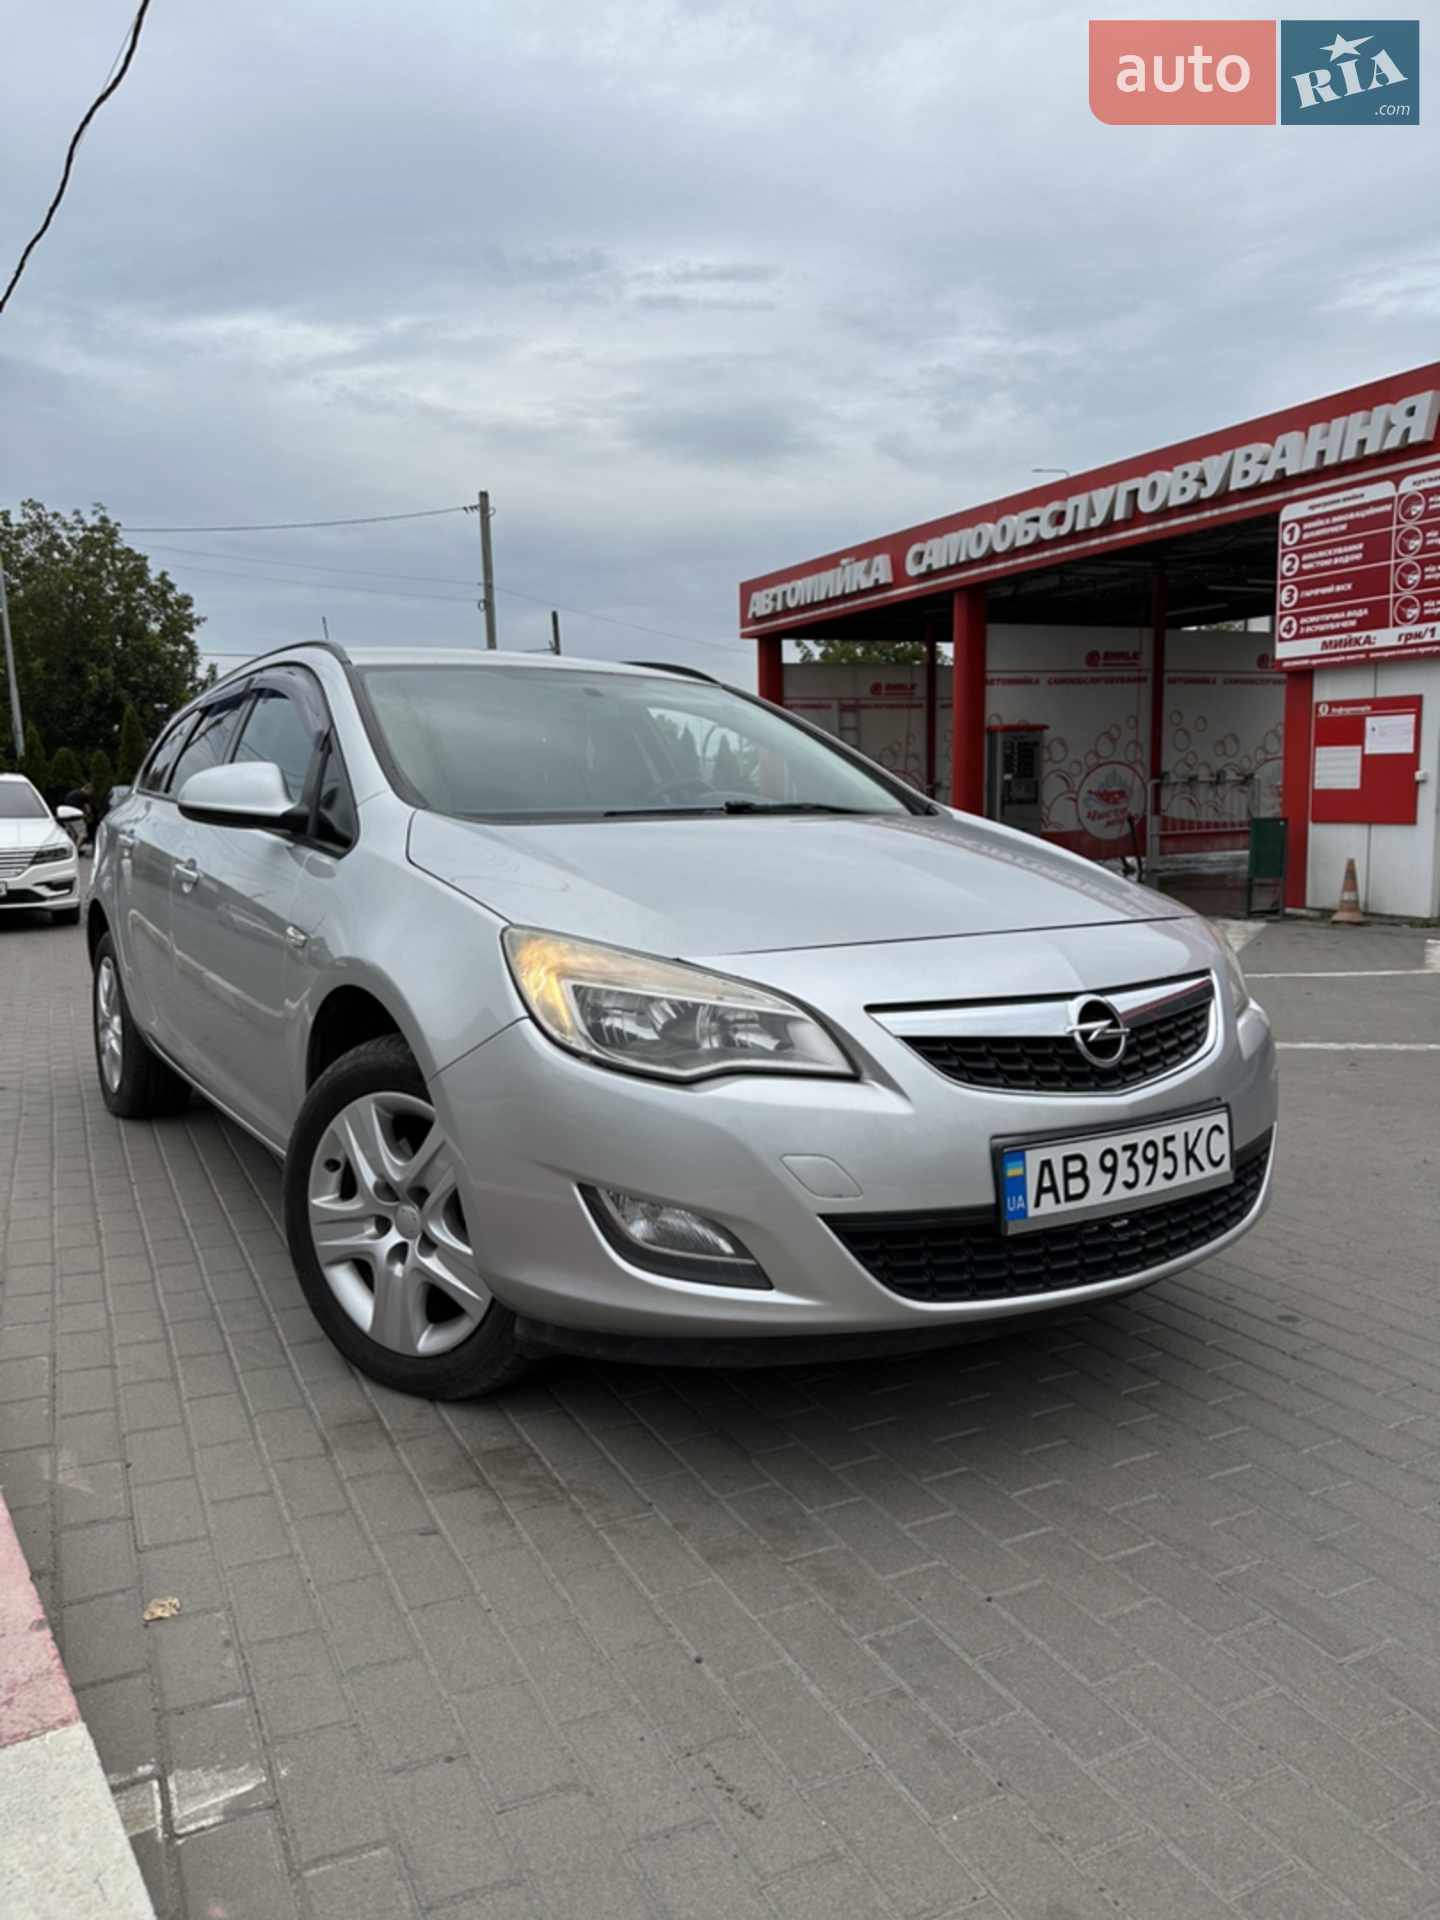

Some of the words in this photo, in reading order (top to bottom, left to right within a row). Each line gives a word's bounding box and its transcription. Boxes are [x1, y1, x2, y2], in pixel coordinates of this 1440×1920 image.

[747, 553, 893, 619] АВТОМИЙКА
[905, 389, 1439, 577] САМООБСЛУГОВУВАННЯ
[1320, 634, 1377, 651] МИЙКА:
[1034, 1152, 1090, 1209] AB
[1099, 1133, 1179, 1196] 9395
[1183, 1123, 1226, 1177] KC
[1007, 1195, 1026, 1212] UA
